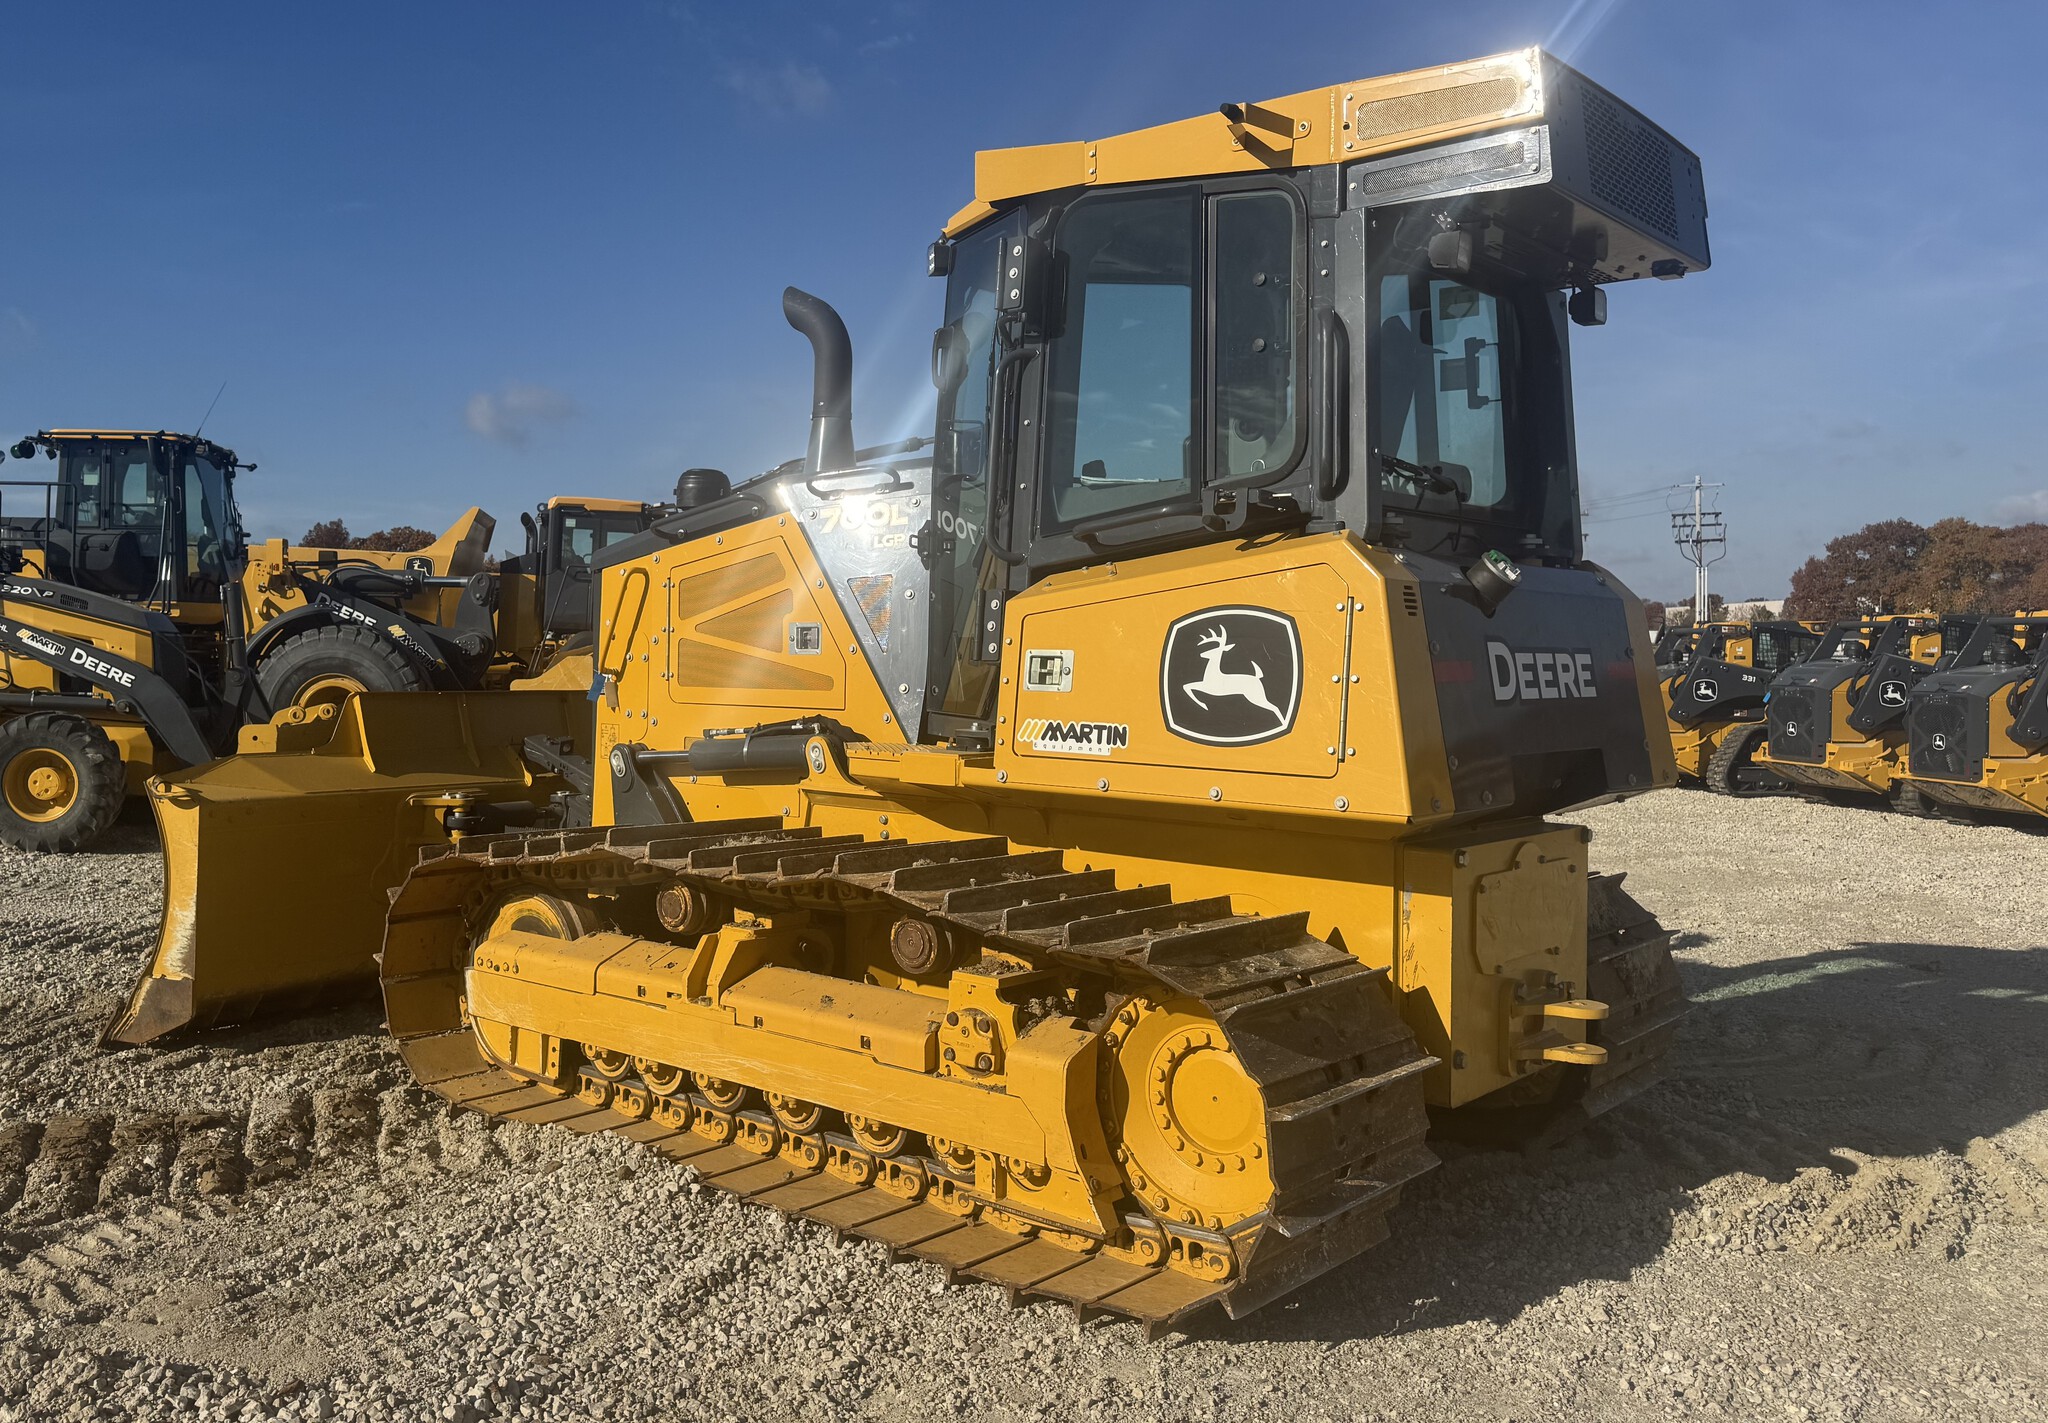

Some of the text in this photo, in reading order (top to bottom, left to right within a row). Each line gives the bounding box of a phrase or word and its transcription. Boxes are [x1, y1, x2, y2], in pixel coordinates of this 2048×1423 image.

[874, 534, 906, 548] LGP
[27, 633, 65, 655] MARTIN
[397, 633, 437, 671] MARTIN
[70, 648, 136, 688] DEERE
[1487, 641, 1597, 700] DEERE
[1742, 674, 1756, 683] 331
[1041, 721, 1127, 747] MARTIN
